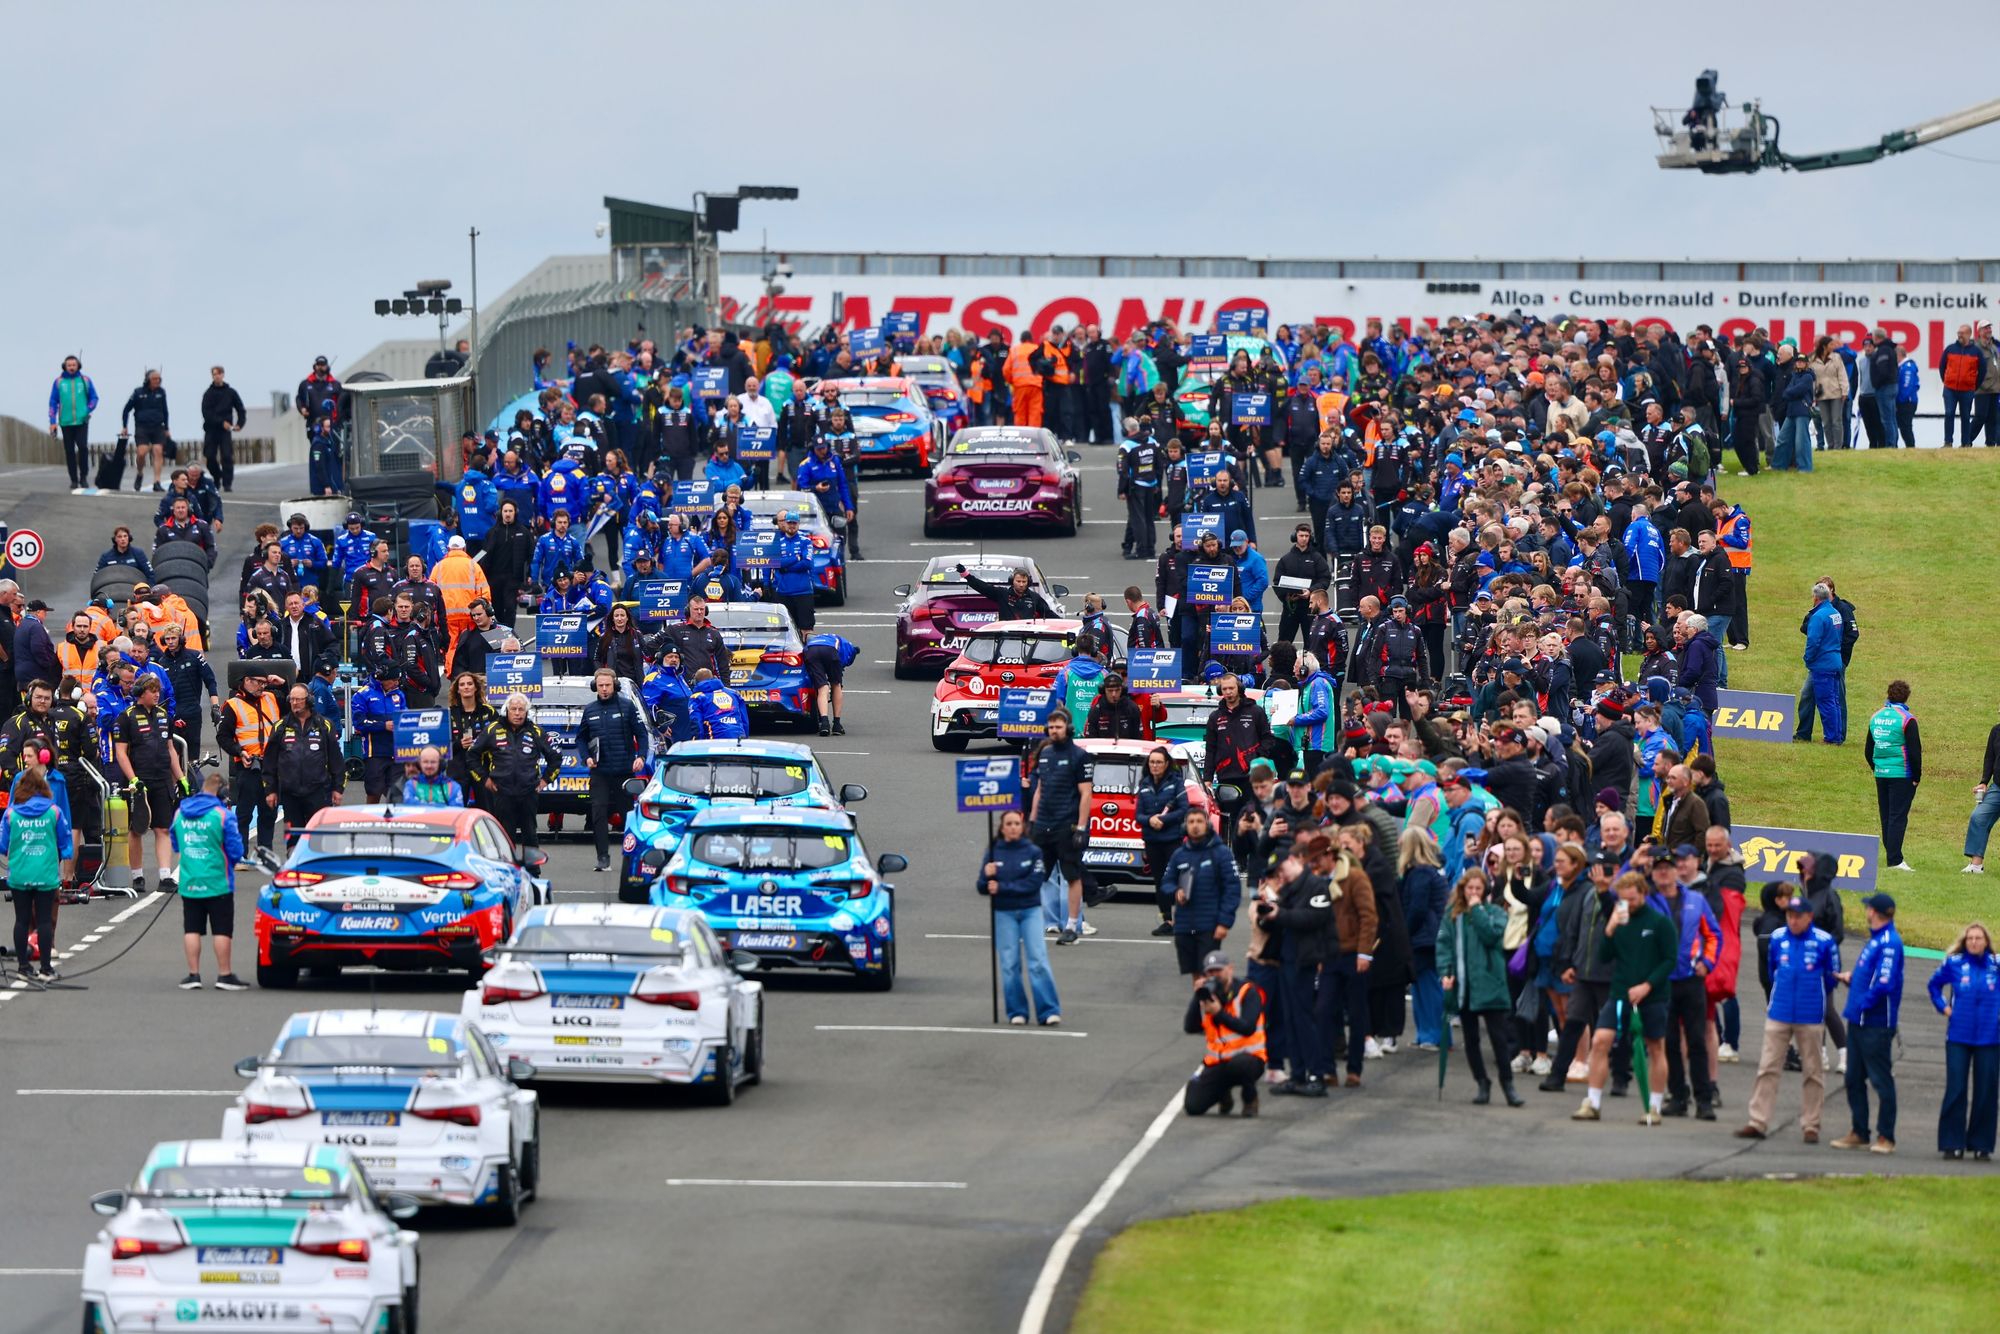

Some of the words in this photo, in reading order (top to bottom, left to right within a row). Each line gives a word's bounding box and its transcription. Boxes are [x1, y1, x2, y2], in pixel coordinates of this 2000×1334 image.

[1491, 290, 1544, 307] Alloa
[1569, 290, 1714, 307] Cumbernauld
[1738, 291, 1870, 308] Dunfermline
[1895, 292, 1988, 309] Penicuik
[1205, 347, 1214, 355] 17
[1247, 407, 1256, 415] 16
[889, 433, 911, 442] Vertu
[751, 441, 762, 449] 77
[687, 495, 699, 504] 50
[961, 500, 1032, 511] CATACLEAN
[12, 541, 37, 557] 30
[753, 547, 764, 555] 15
[746, 557, 770, 565] SELBY
[1202, 583, 1218, 592] 132
[657, 598, 670, 607] 22
[649, 609, 679, 617] SMILEY
[961, 613, 996, 622] KwikFit
[554, 634, 569, 643] 27
[1231, 632, 1239, 641] 3
[541, 646, 582, 654] CAMMISH
[1218, 643, 1253, 651] CHILTON
[1151, 668, 1159, 678] 7
[506, 673, 523, 684] 55
[1072, 679, 1096, 687] Vertu
[1132, 679, 1176, 688] BENSLEY
[489, 684, 541, 696] HALSTEAD
[1029, 694, 1047, 702] BTCC
[421, 715, 439, 723] BTCC
[719, 716, 737, 724] TEAM
[1018, 710, 1037, 721] 99
[1713, 707, 1784, 731] EAR
[1874, 717, 1893, 726] Vertu
[1001, 723, 1045, 734] RAINFOR
[412, 732, 429, 744] 28
[559, 777, 591, 791] PART
[978, 781, 999, 795] 29
[1093, 784, 1140, 794] ensley
[965, 793, 1014, 806] GILBERT
[17, 819, 46, 828] Vertu
[738, 855, 802, 868] Tylor-Smh
[1082, 849, 1129, 864] KwikFit
[1762, 849, 1865, 878] YER
[350, 888, 398, 897] GENESYS
[731, 894, 803, 916] LASER
[279, 910, 314, 923] Vertu
[421, 910, 460, 924] Vertu
[340, 916, 393, 930] KwikFit
[737, 934, 790, 949] KwikFit
[556, 994, 613, 1008] KwikFit
[552, 1015, 592, 1027] LKQ
[327, 1111, 389, 1126] KwikFit
[324, 1134, 367, 1146] LKQ
[202, 1249, 270, 1264] KwikFit
